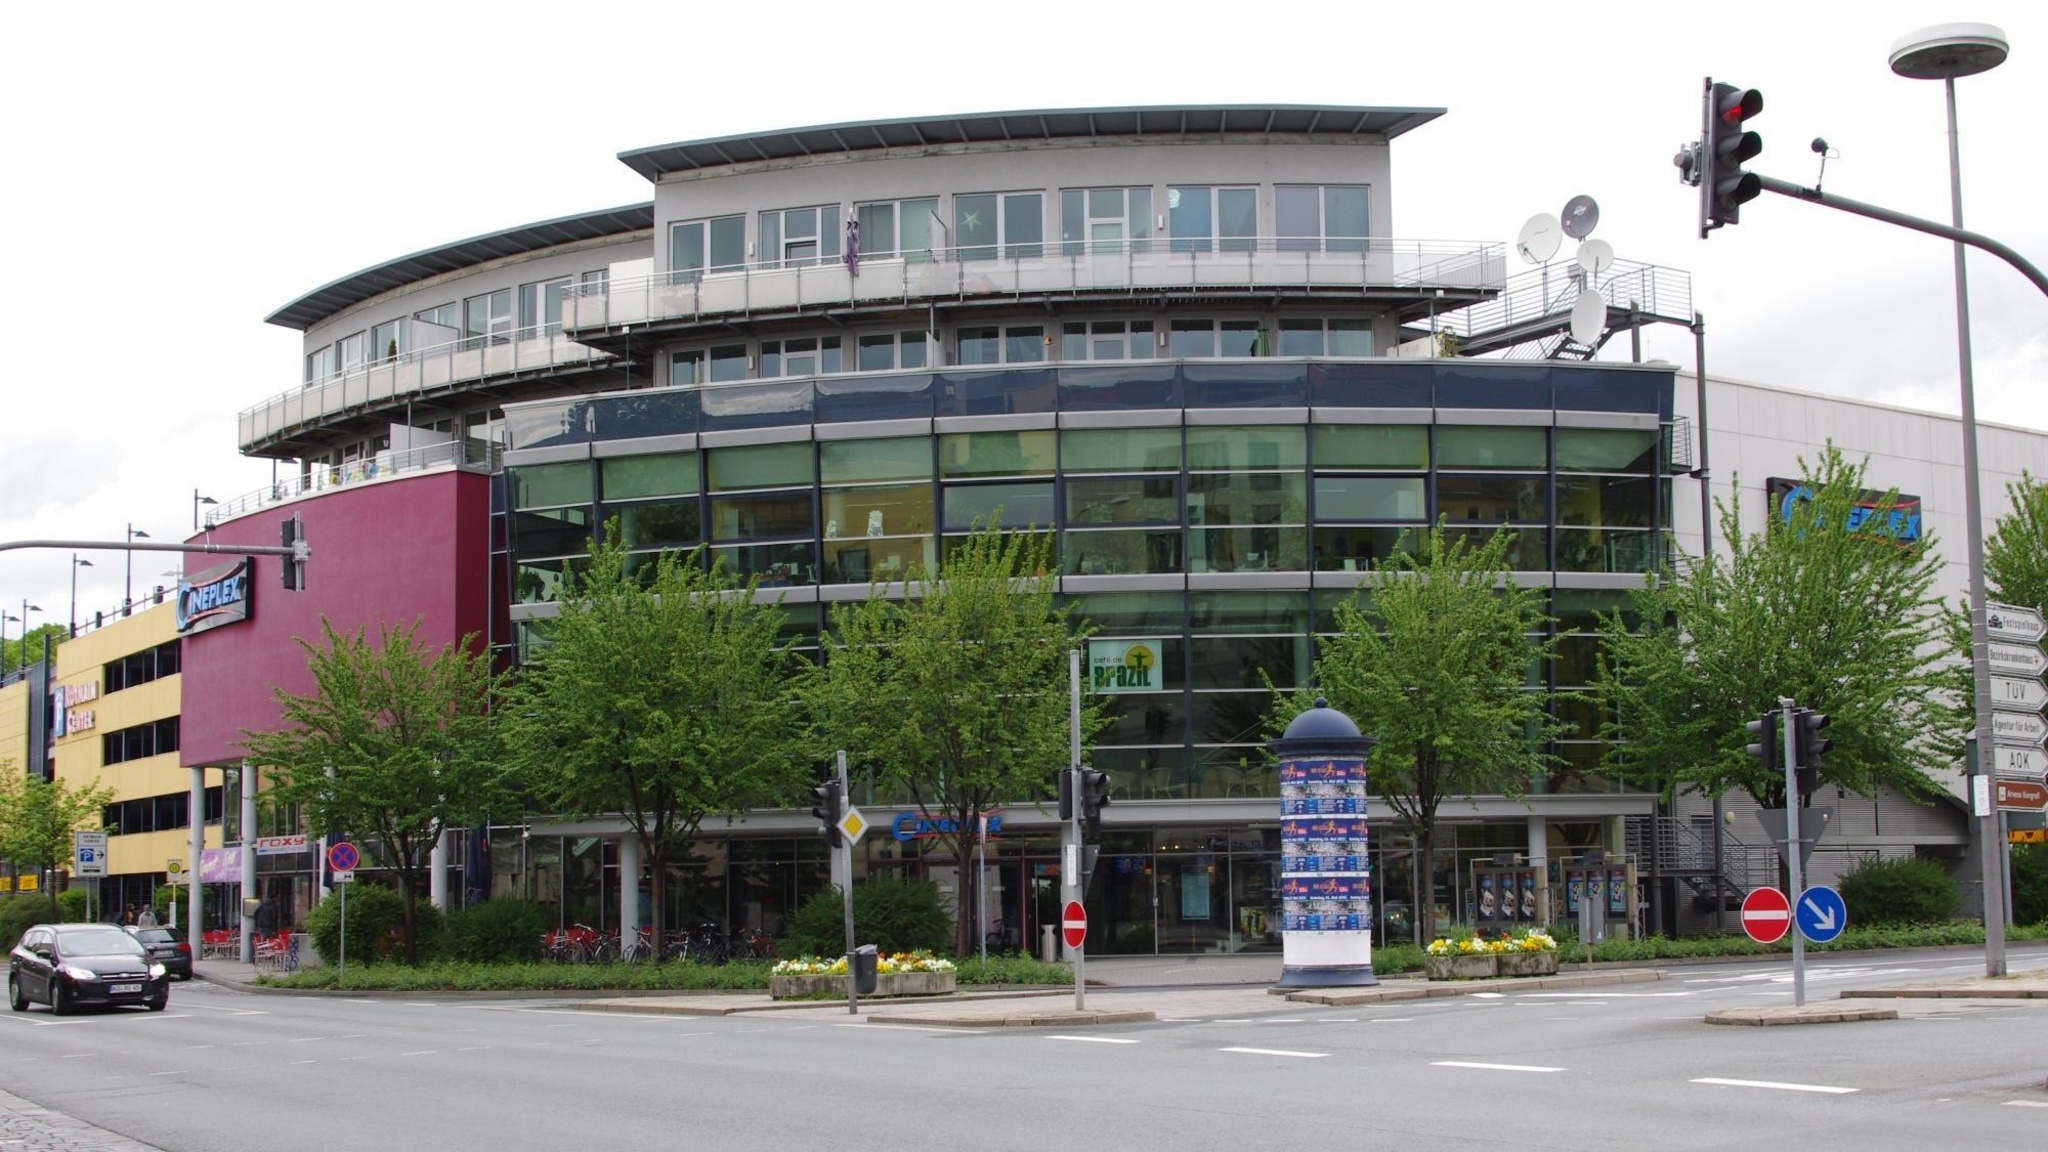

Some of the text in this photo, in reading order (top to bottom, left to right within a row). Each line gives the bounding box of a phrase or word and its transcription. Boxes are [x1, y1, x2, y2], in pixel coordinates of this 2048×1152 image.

[176, 576, 240, 630] CINEPLEX
[2003, 616, 2039, 632] Festspielhaus
[2006, 682, 2026, 700] TÜV
[1994, 718, 2040, 734] Agentur für Arbeit
[2010, 752, 2030, 770] AOK
